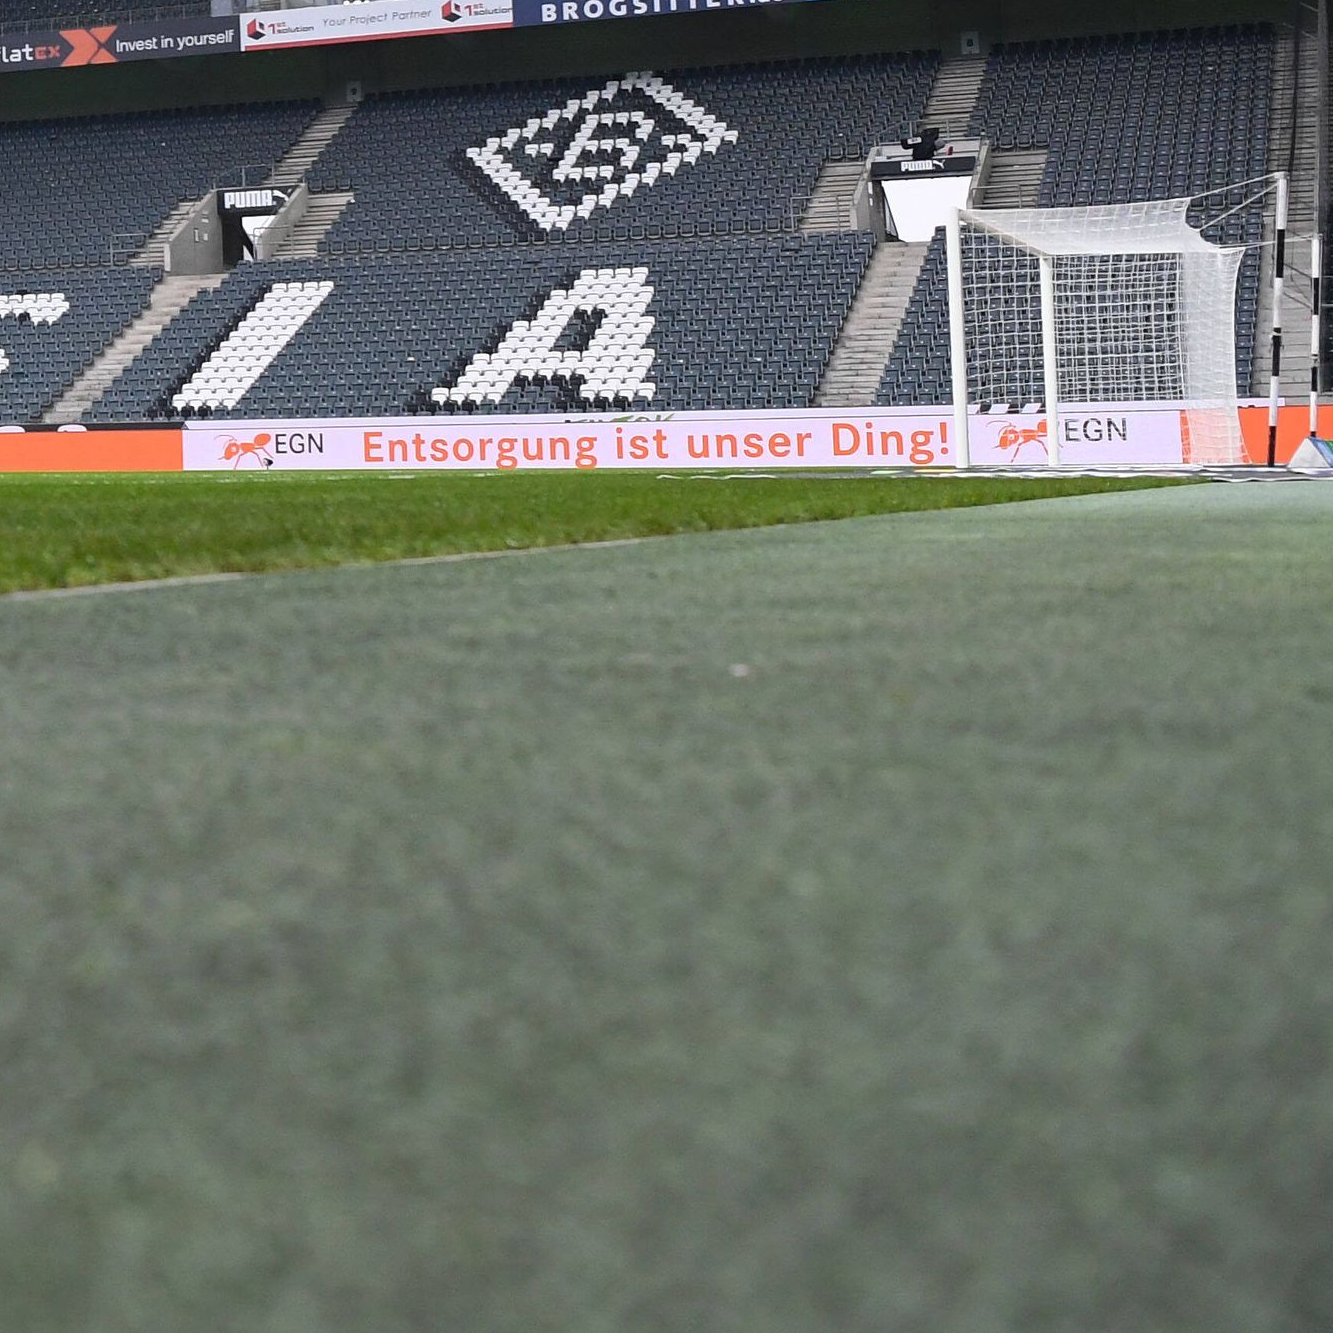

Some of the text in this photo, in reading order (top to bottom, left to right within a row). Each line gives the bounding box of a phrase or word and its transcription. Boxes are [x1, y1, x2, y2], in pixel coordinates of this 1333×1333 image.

[322, 9, 431, 27] Your Project Partner
[116, 29, 235, 52] Invest in yourself
[224, 189, 274, 209] PUMA
[1064, 417, 1127, 442] EGN
[275, 422, 949, 469] EGN Entsorgung ist unser Ding!
